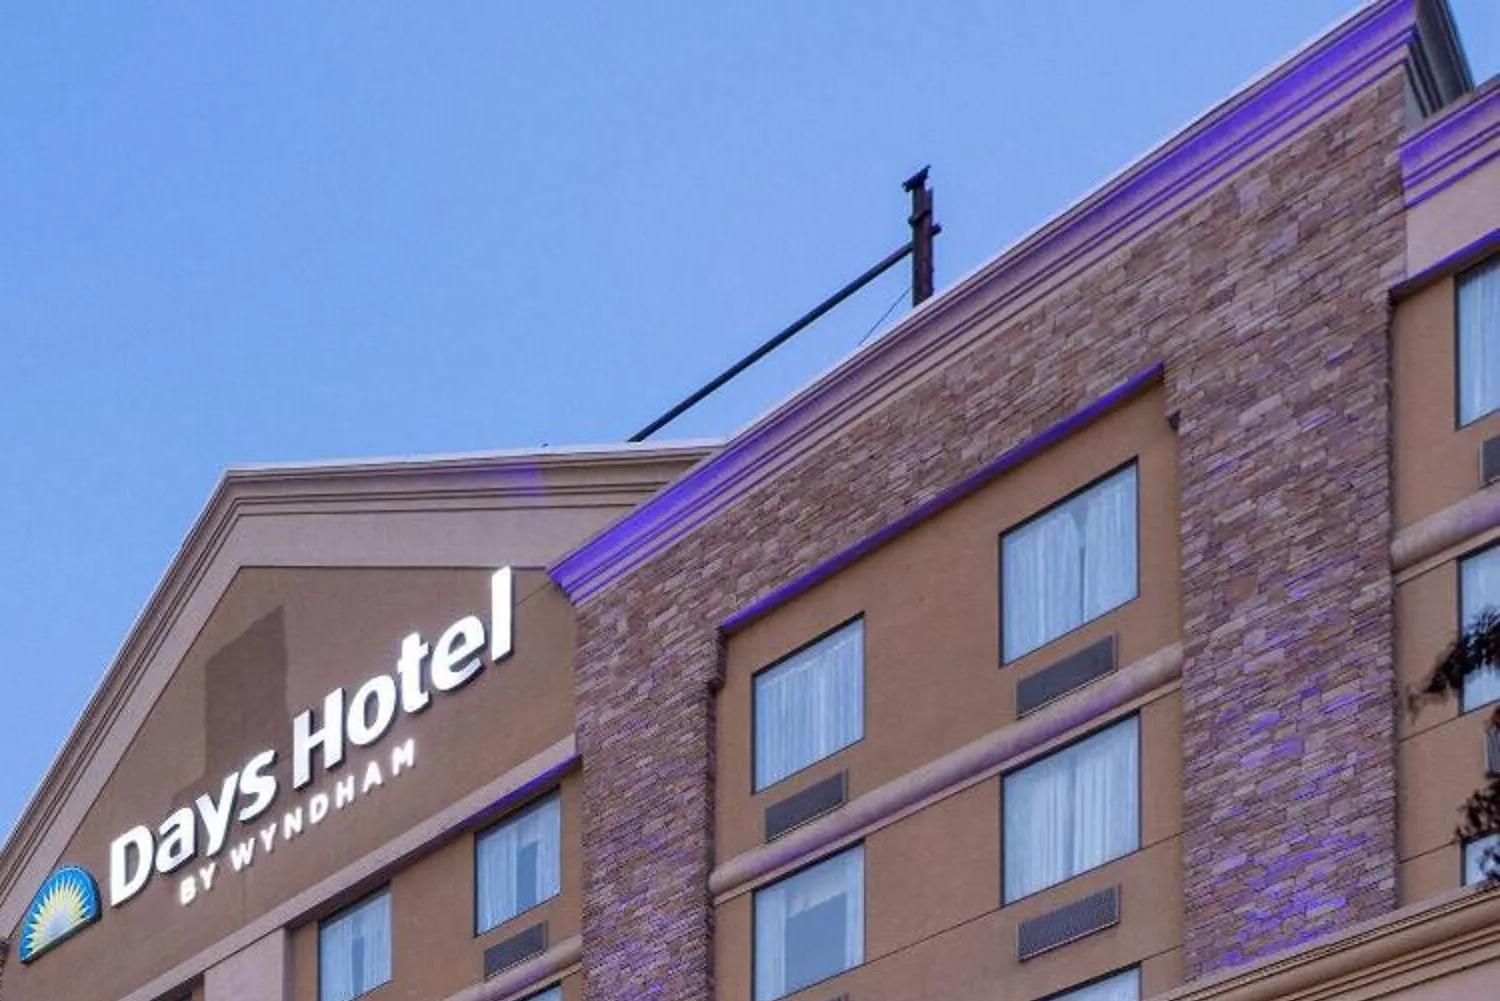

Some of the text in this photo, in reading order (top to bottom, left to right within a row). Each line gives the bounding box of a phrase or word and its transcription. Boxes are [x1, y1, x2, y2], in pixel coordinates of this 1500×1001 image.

[109, 565, 514, 908] Days Hotel
[179, 738, 418, 906] BY WYNDHAM
